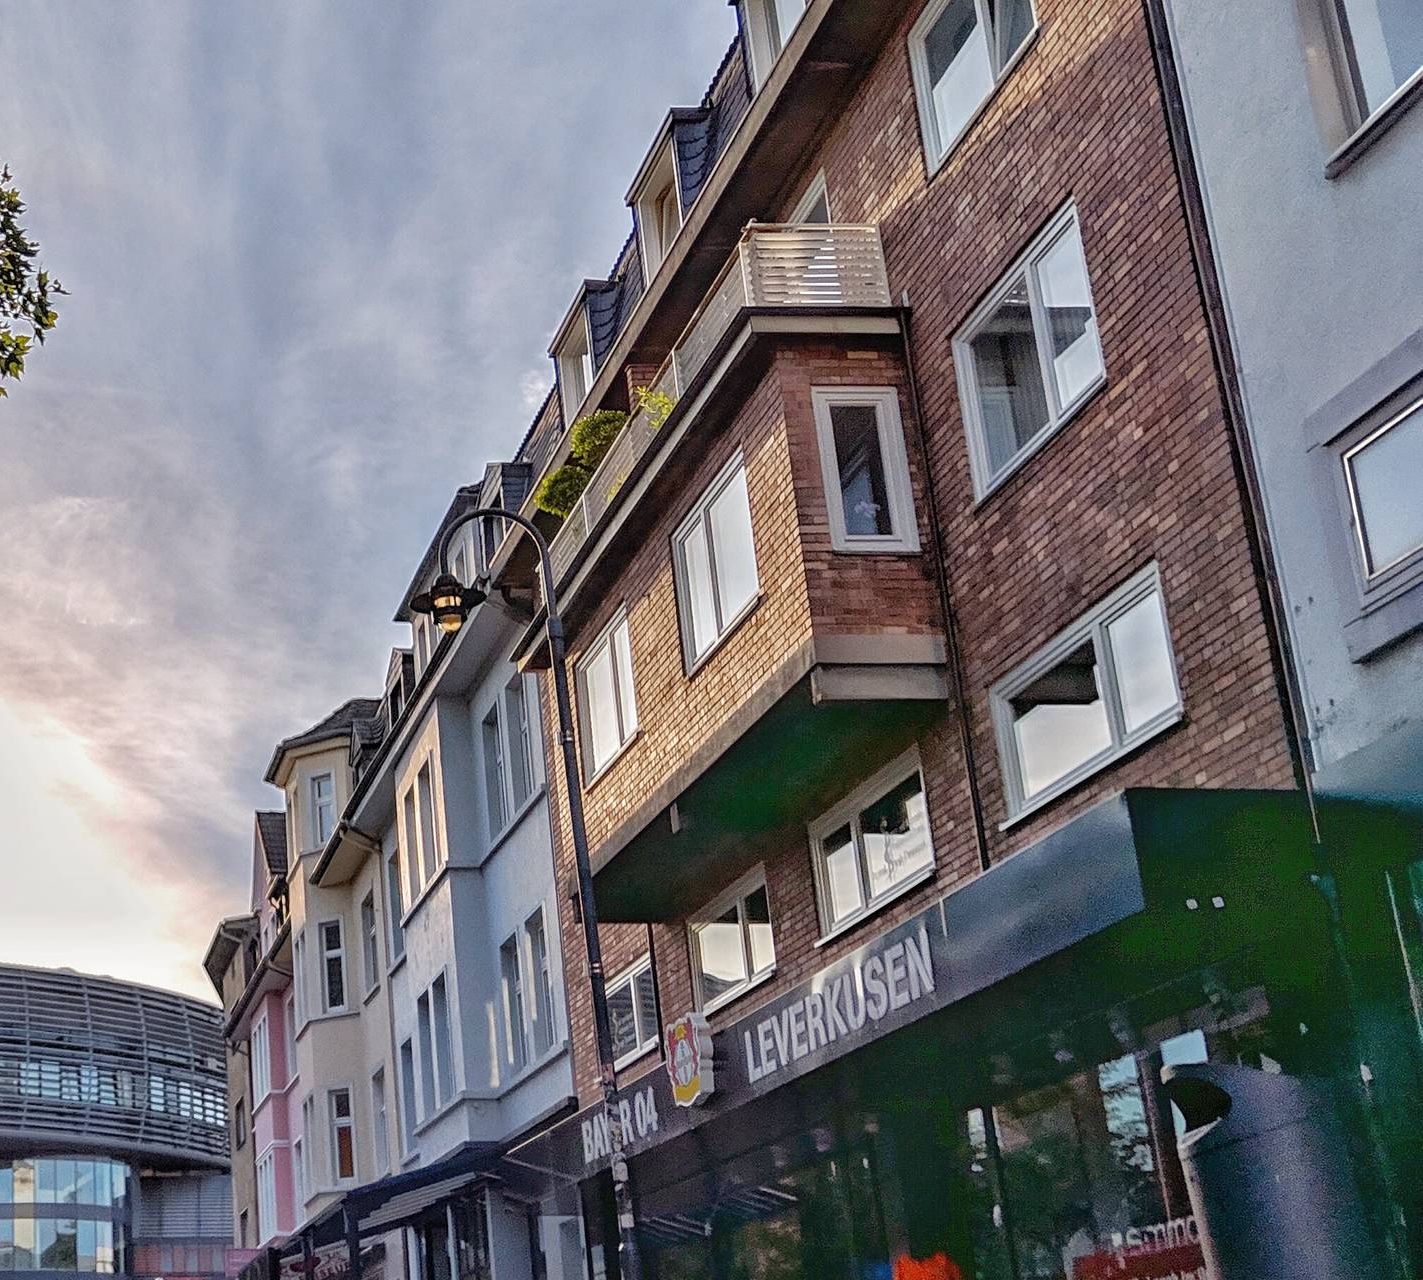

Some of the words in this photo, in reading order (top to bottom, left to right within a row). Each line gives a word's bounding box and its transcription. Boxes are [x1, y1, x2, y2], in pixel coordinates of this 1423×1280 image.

[581, 1099, 635, 1165] BAYR
[634, 1085, 659, 1138] 04
[744, 926, 935, 1084] LEVERKUSEN
